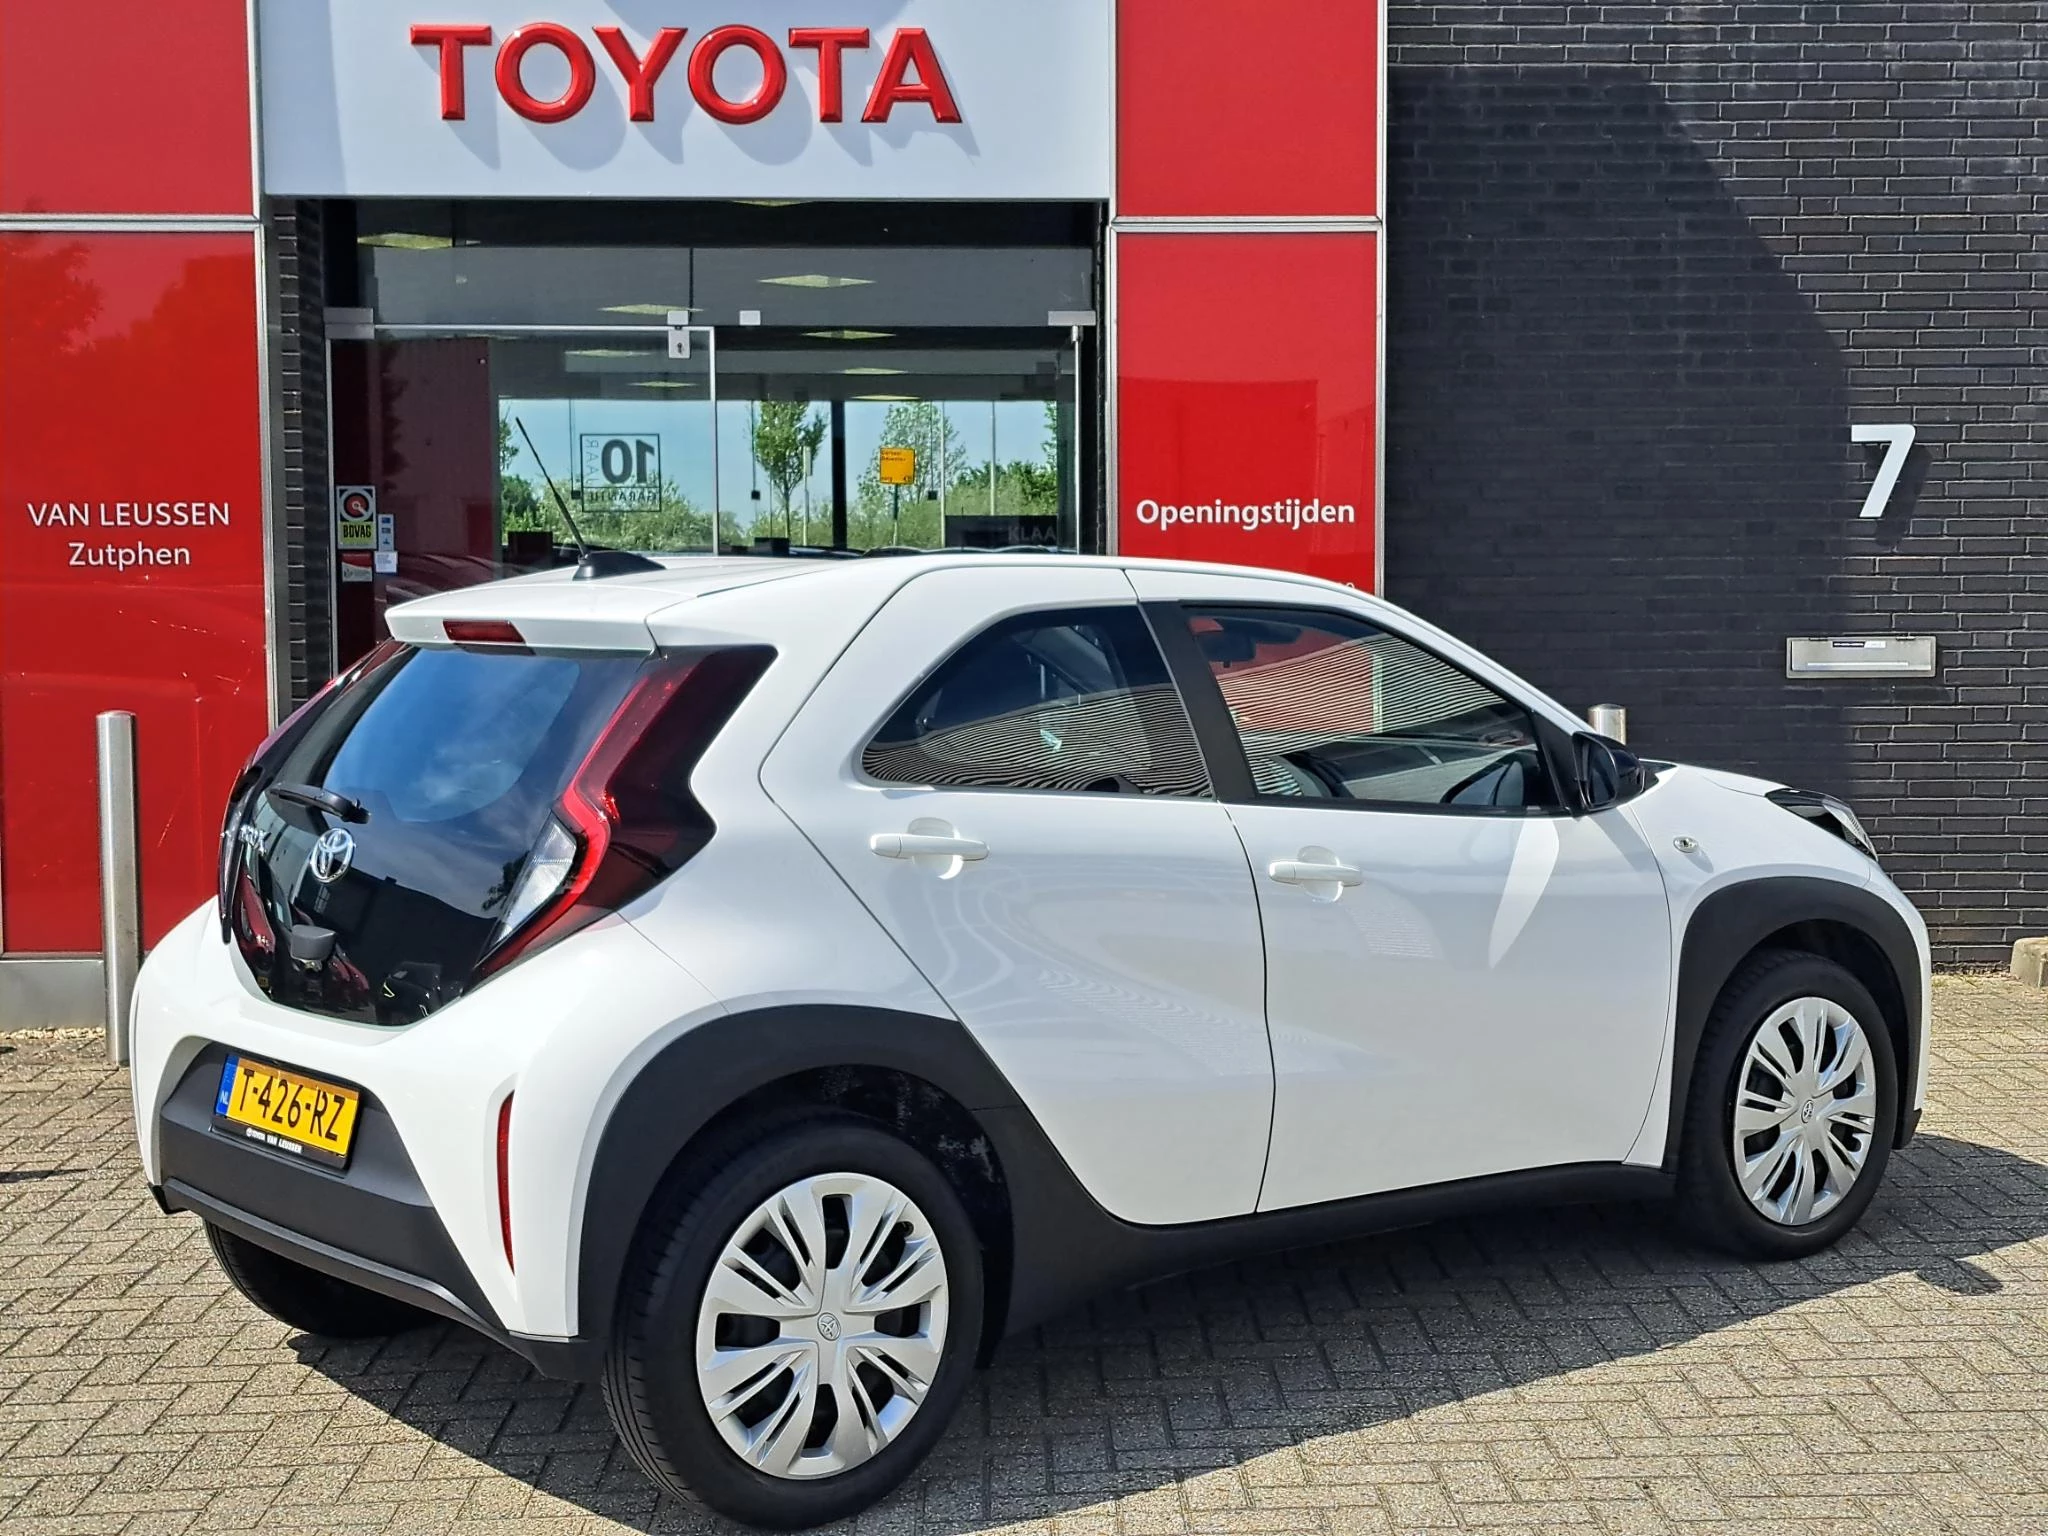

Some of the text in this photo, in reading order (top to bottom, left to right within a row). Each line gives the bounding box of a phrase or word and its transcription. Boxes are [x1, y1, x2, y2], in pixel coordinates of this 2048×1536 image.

[409, 22, 963, 125] TOYOTA
[1851, 424, 1916, 518] 7
[27, 502, 230, 527] VAN LEUSSEN
[1136, 499, 1355, 531] Openingstijden
[343, 524, 372, 538] BOVAG
[68, 541, 191, 571] Zutphen
[239, 1068, 346, 1141] T-426-RZ
